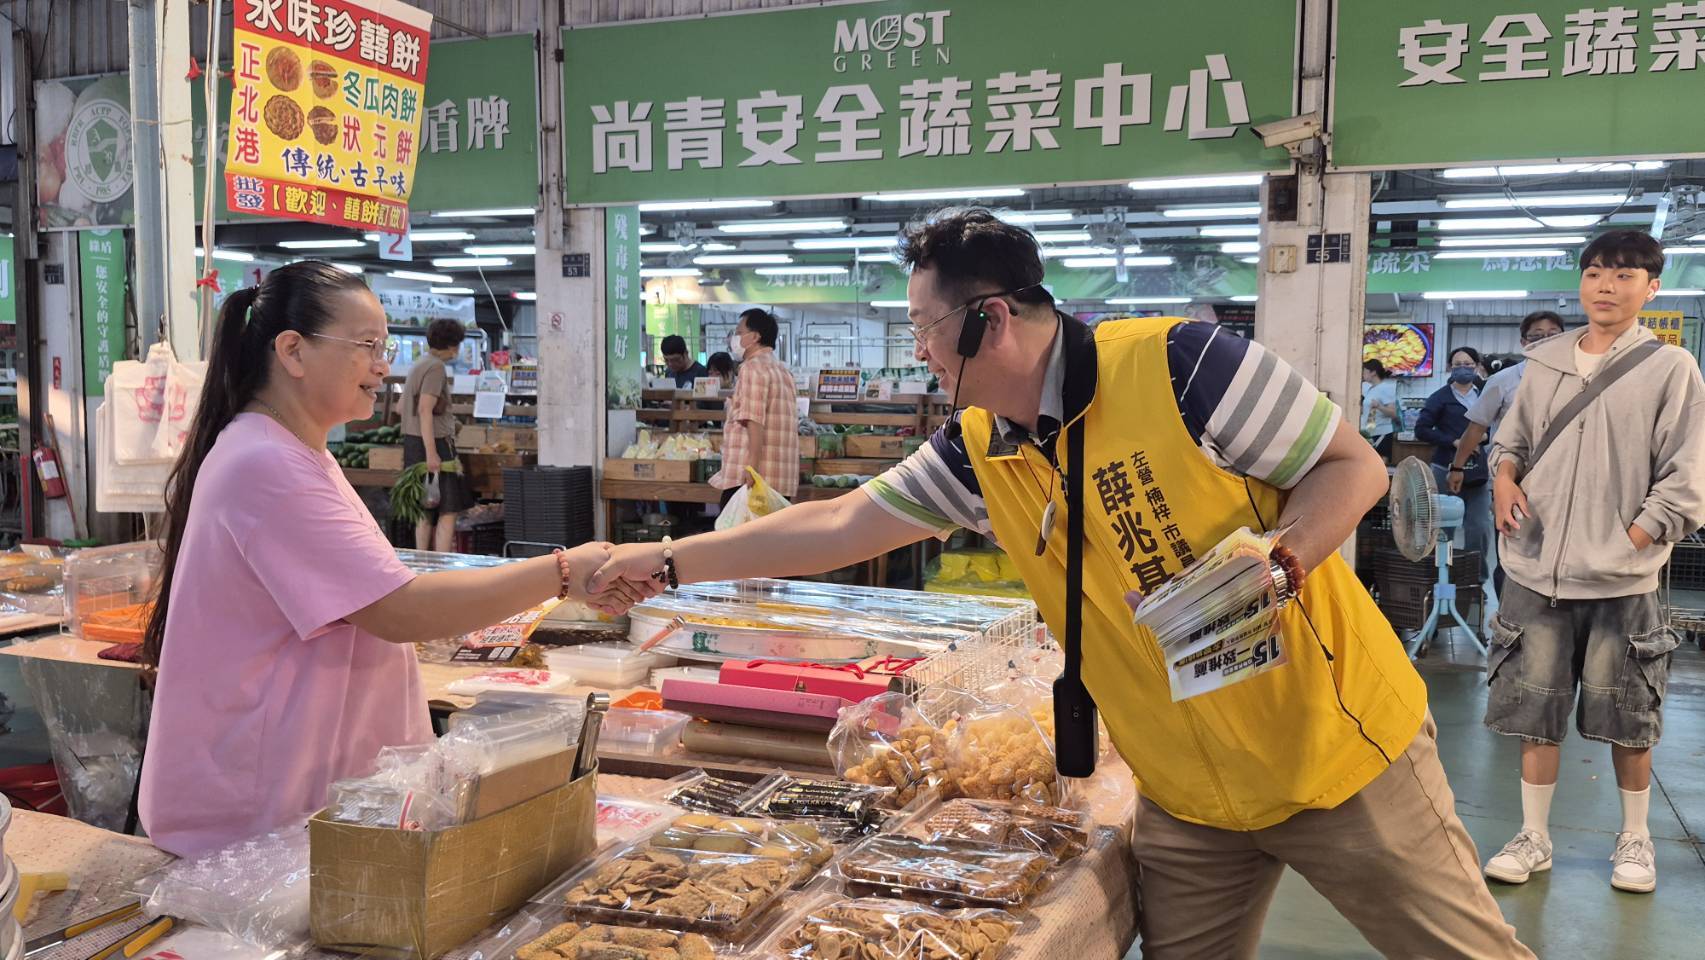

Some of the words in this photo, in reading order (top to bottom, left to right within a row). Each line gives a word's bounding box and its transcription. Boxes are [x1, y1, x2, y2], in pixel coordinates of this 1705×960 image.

[834, 46, 951, 73] GREEN
[1397, 2, 1705, 87] 安全蔬菜
[235, 42, 262, 164] 正北港
[343, 71, 417, 124] 冬瓜肉餅
[592, 53, 1251, 174] 尚青安全蔬菜中心
[342, 115, 413, 165] 狀元餅
[234, 175, 265, 210] 批發
[282, 148, 406, 197] 傳統、古早味
[388, 233, 404, 255] 2
[1315, 250, 1330, 261] 55
[1366, 252, 1431, 274] 蔬菜
[568, 267, 578, 276] 53
[614, 213, 629, 360] 殘毒把關好
[1092, 461, 1175, 595] 薛兆基
[1194, 648, 1250, 678] 一致推薦
[1253, 634, 1280, 669] 15
